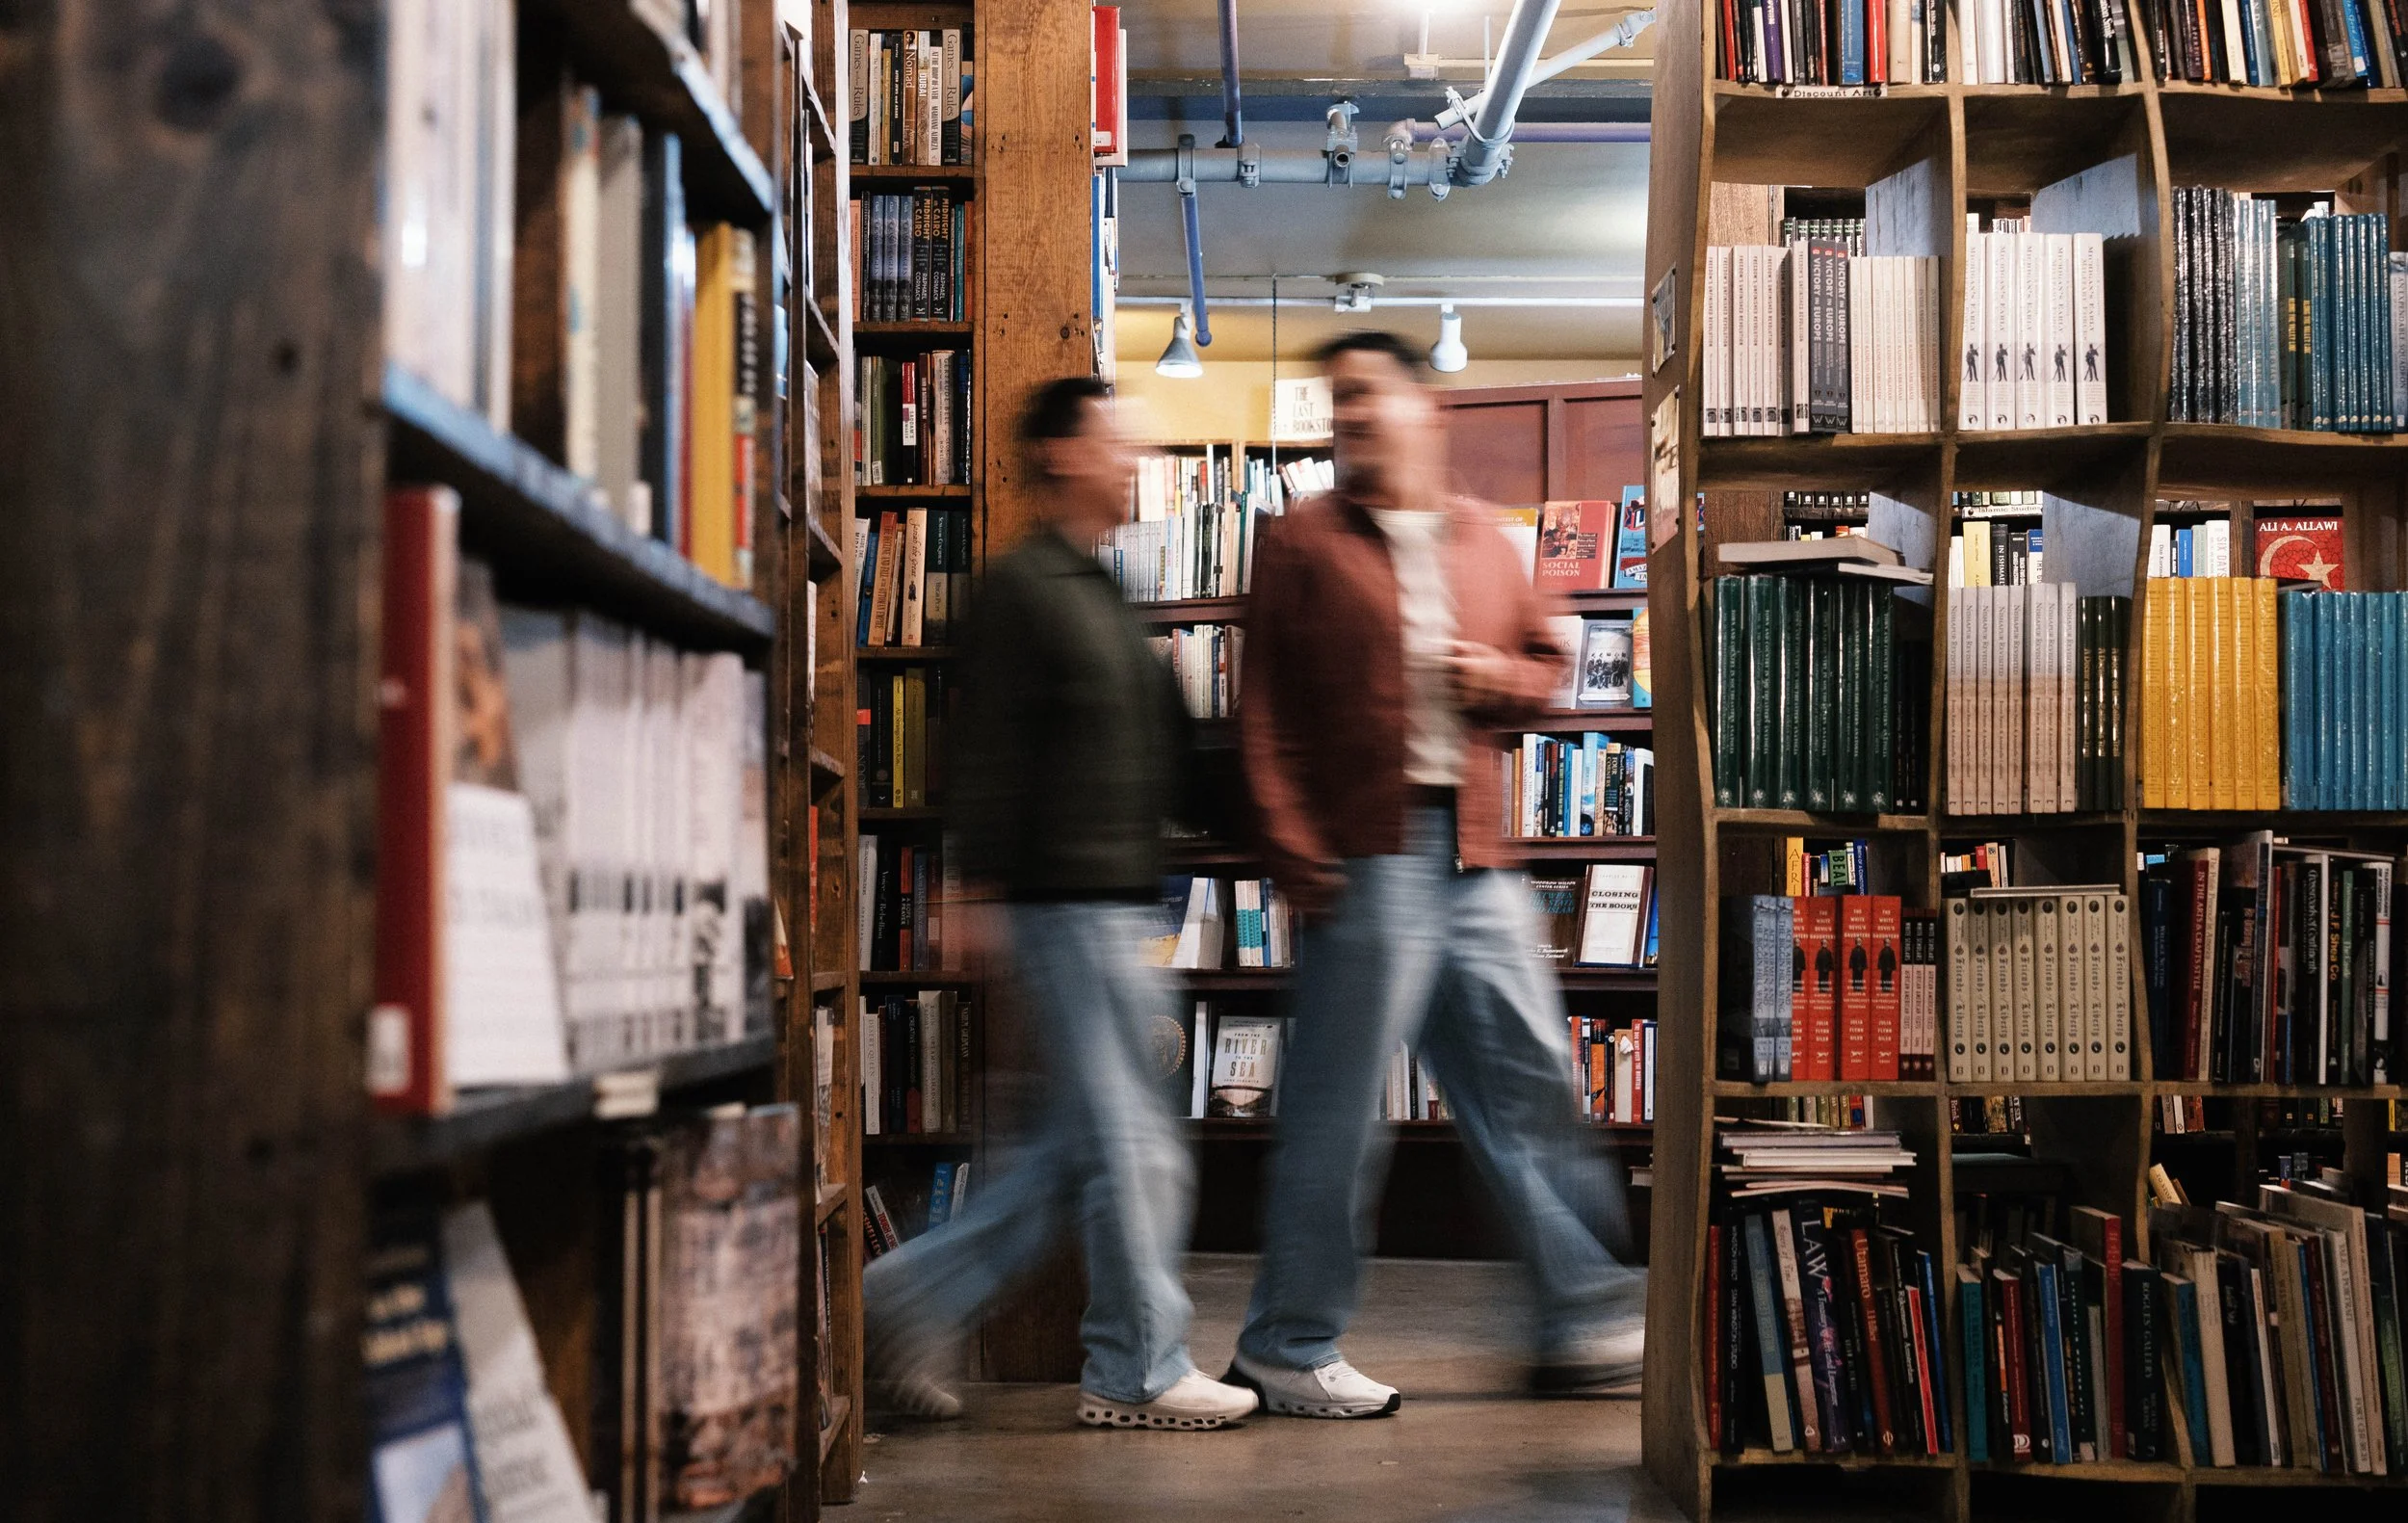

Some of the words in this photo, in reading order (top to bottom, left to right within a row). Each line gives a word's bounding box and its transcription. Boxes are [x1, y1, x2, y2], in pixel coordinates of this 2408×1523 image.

[2102, 17, 2115, 39] Smile
[853, 35, 865, 70] Games
[947, 35, 957, 69] Games
[905, 51, 915, 88] Nomad
[854, 86, 865, 116] Rules
[947, 87, 957, 116] Rules
[2397, 277, 2405, 289] AN
[2397, 290, 2406, 342] EXPENDABLE
[2398, 344, 2407, 389] SQUADRON
[1294, 403, 1314, 417] LAST
[1295, 386, 1308, 401] THE
[2259, 522, 2278, 532] ALI
[2280, 522, 2291, 532] A.
[2294, 520, 2339, 531] ALLAWI
[1999, 545, 2004, 554] IN
[2217, 537, 2227, 551] SIX
[2198, 872, 2205, 880] IN
[2307, 870, 2317, 916] Crossroads
[2194, 932, 2203, 963] CRAFTS
[2307, 927, 2317, 974] Continents
[2330, 933, 2340, 961] Shea
[1956, 958, 1965, 992] Friends
[2116, 956, 2125, 991] Friends
[1955, 1005, 1966, 1038] Liberty
[2116, 1003, 2125, 1037] Liberty
[1225, 1038, 1267, 1055] RIVER
[1230, 1062, 1255, 1077] SEA
[1801, 1220, 1827, 1279] LAW
[1854, 1239, 1871, 1299] Utamaro
[2142, 1282, 2152, 1327] ROGUES'
[1903, 1342, 1915, 1384] Amsterdam
[2143, 1331, 2153, 1379] GALLERY
